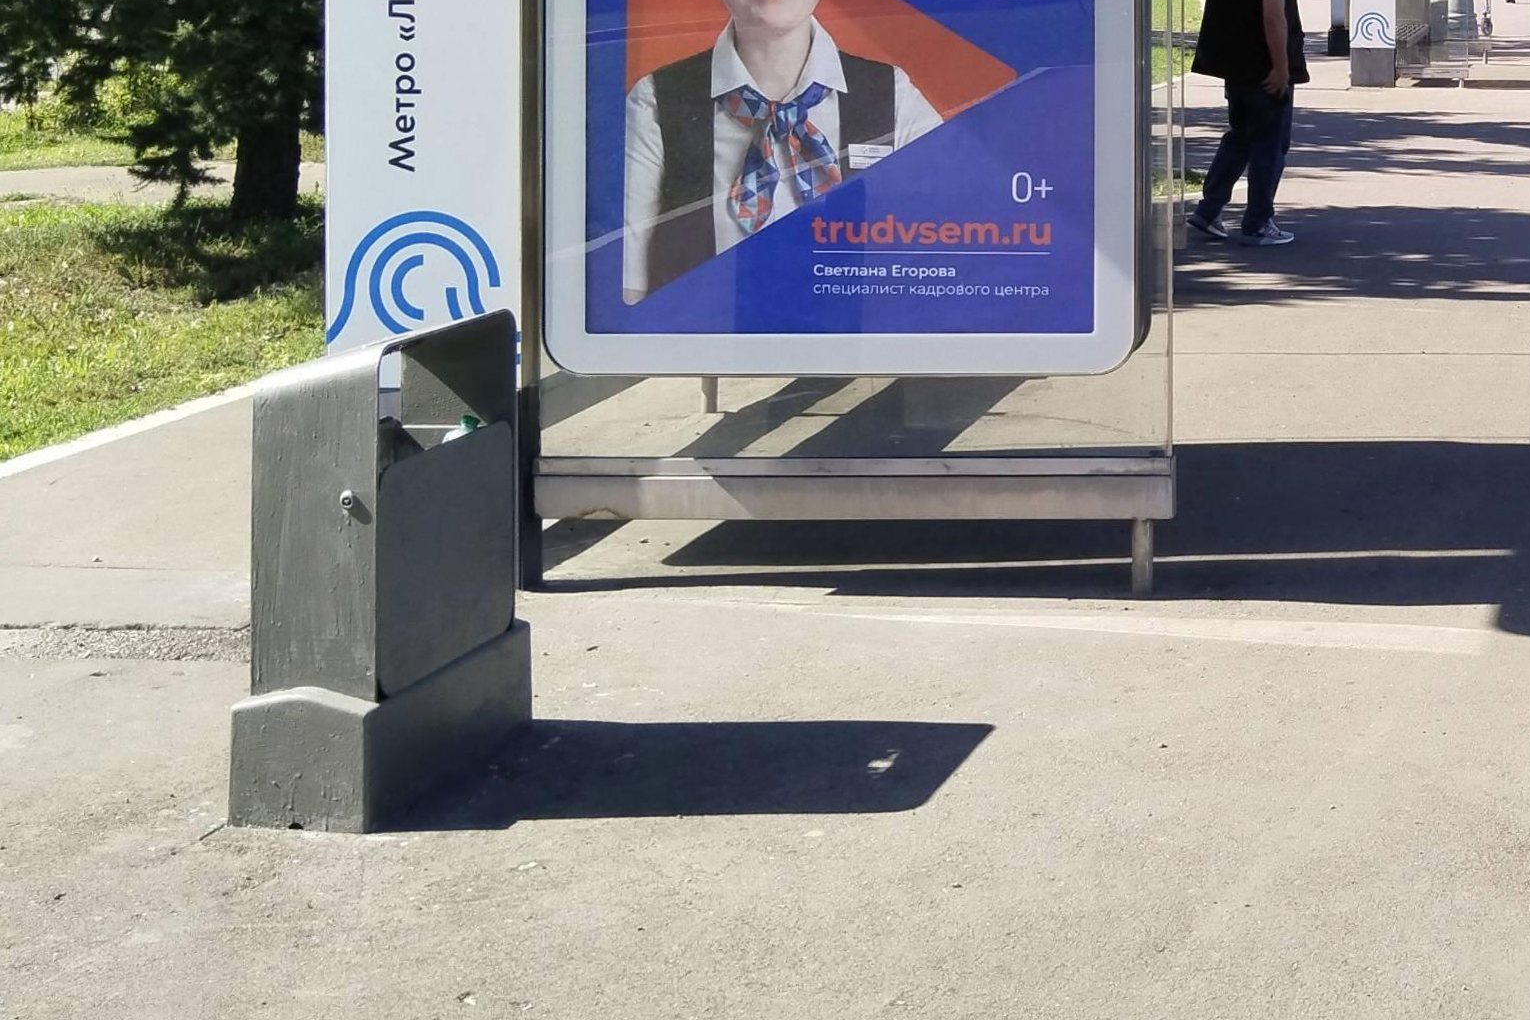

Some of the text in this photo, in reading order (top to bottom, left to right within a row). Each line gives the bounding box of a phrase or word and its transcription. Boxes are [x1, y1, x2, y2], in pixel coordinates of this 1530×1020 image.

[388, 52, 422, 172] Метро
[1011, 171, 1053, 203] 0+
[812, 214, 1052, 245] trudvsem.ru
[813, 264, 956, 279] Светлана Егорова
[813, 283, 1049, 297] специалист кадрового центра
